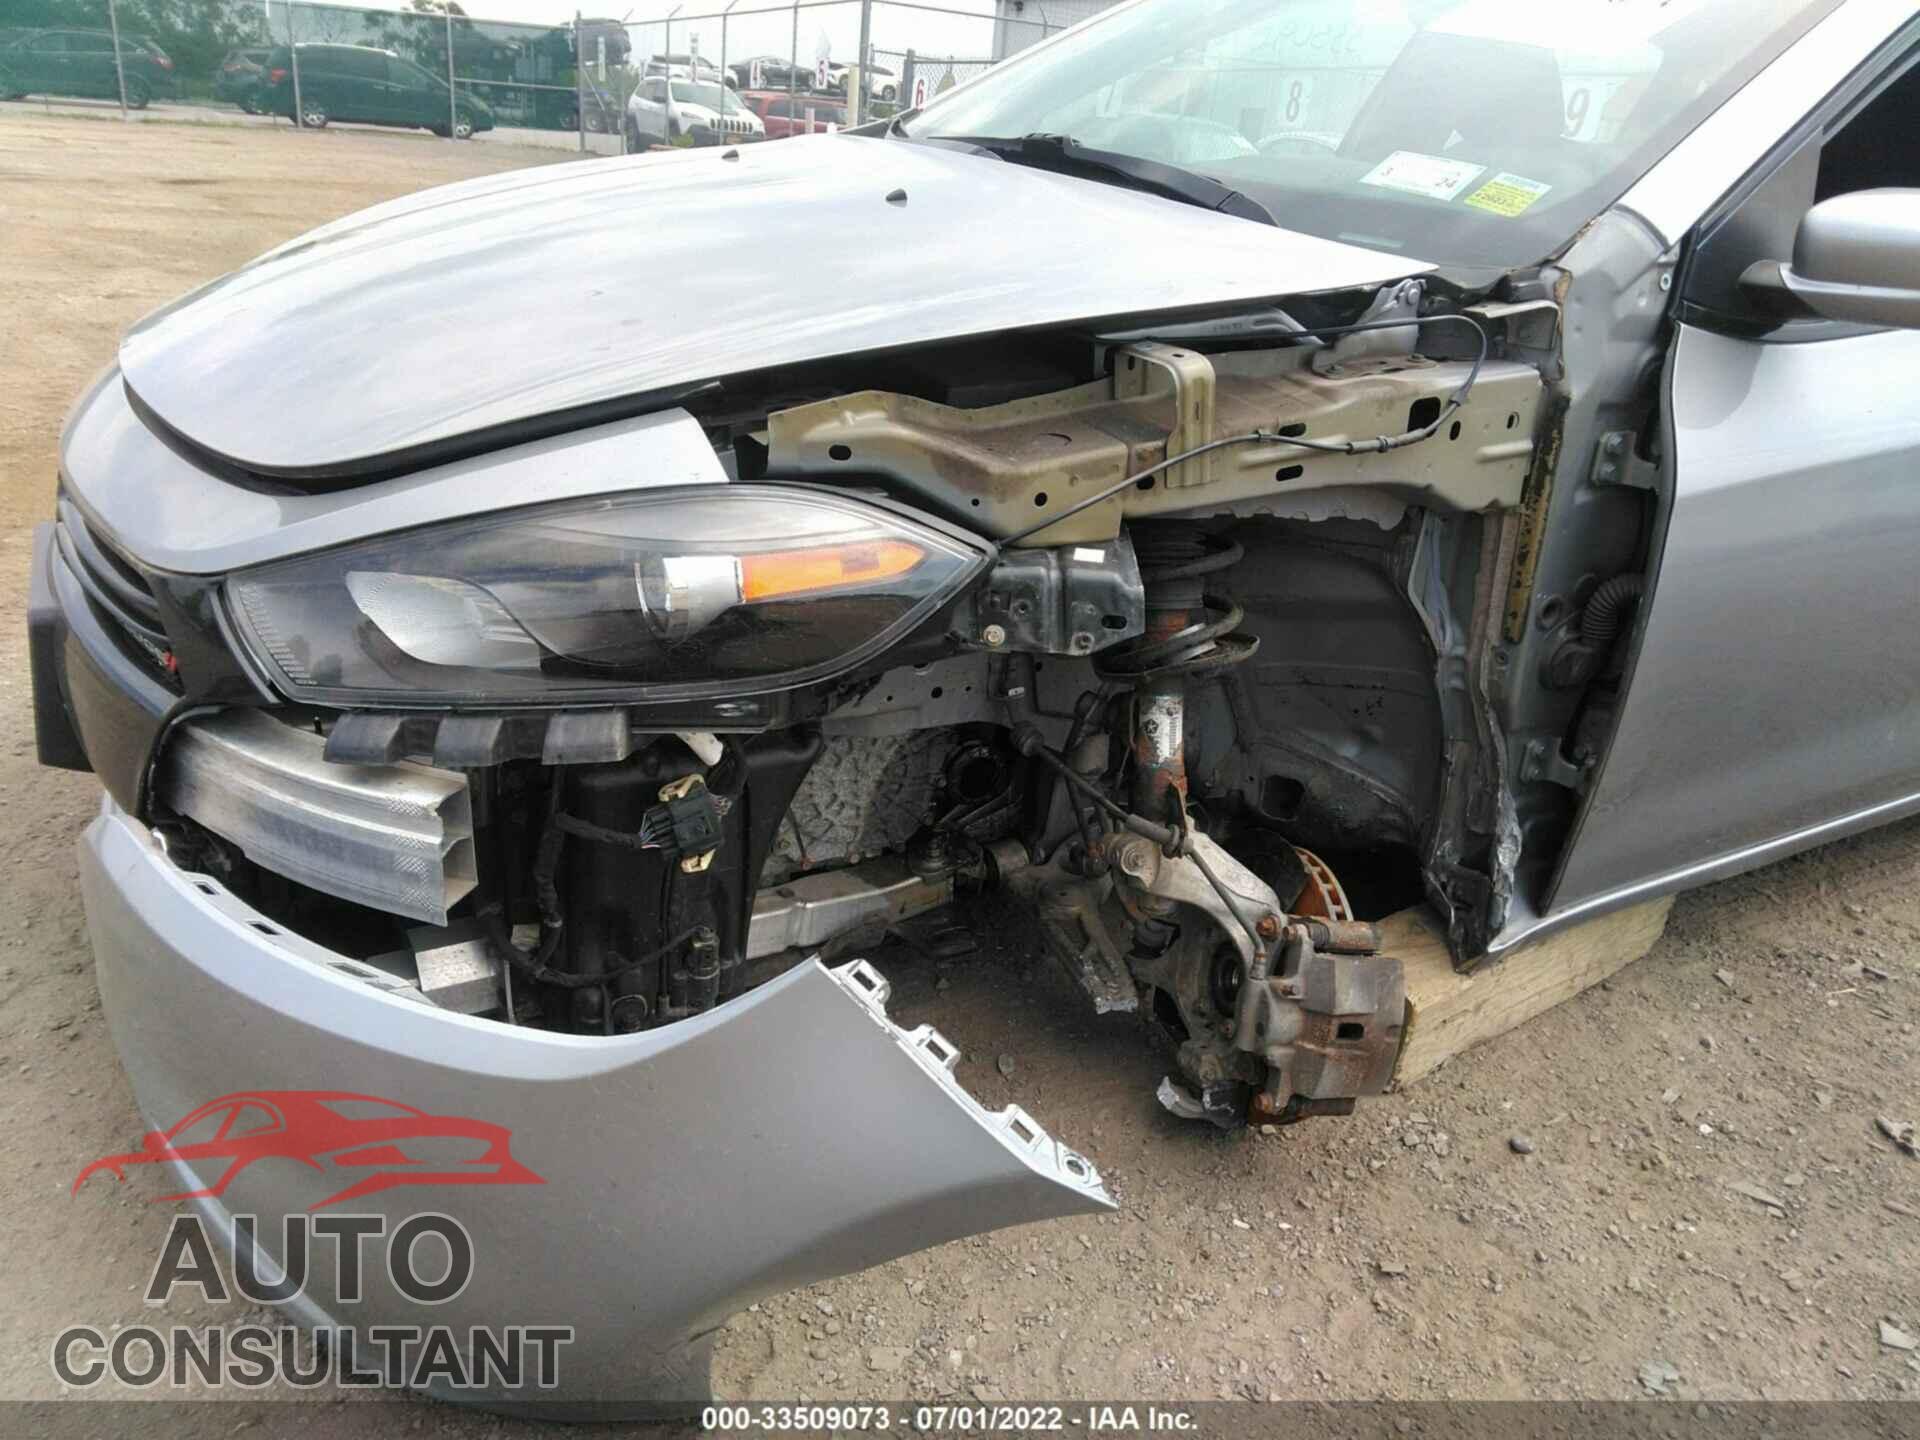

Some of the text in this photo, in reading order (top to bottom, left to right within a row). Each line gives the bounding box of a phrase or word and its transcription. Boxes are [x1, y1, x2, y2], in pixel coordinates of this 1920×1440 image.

[914, 78, 926, 112] 6
[1286, 79, 1303, 122] 8
[1562, 87, 1592, 137] 9
